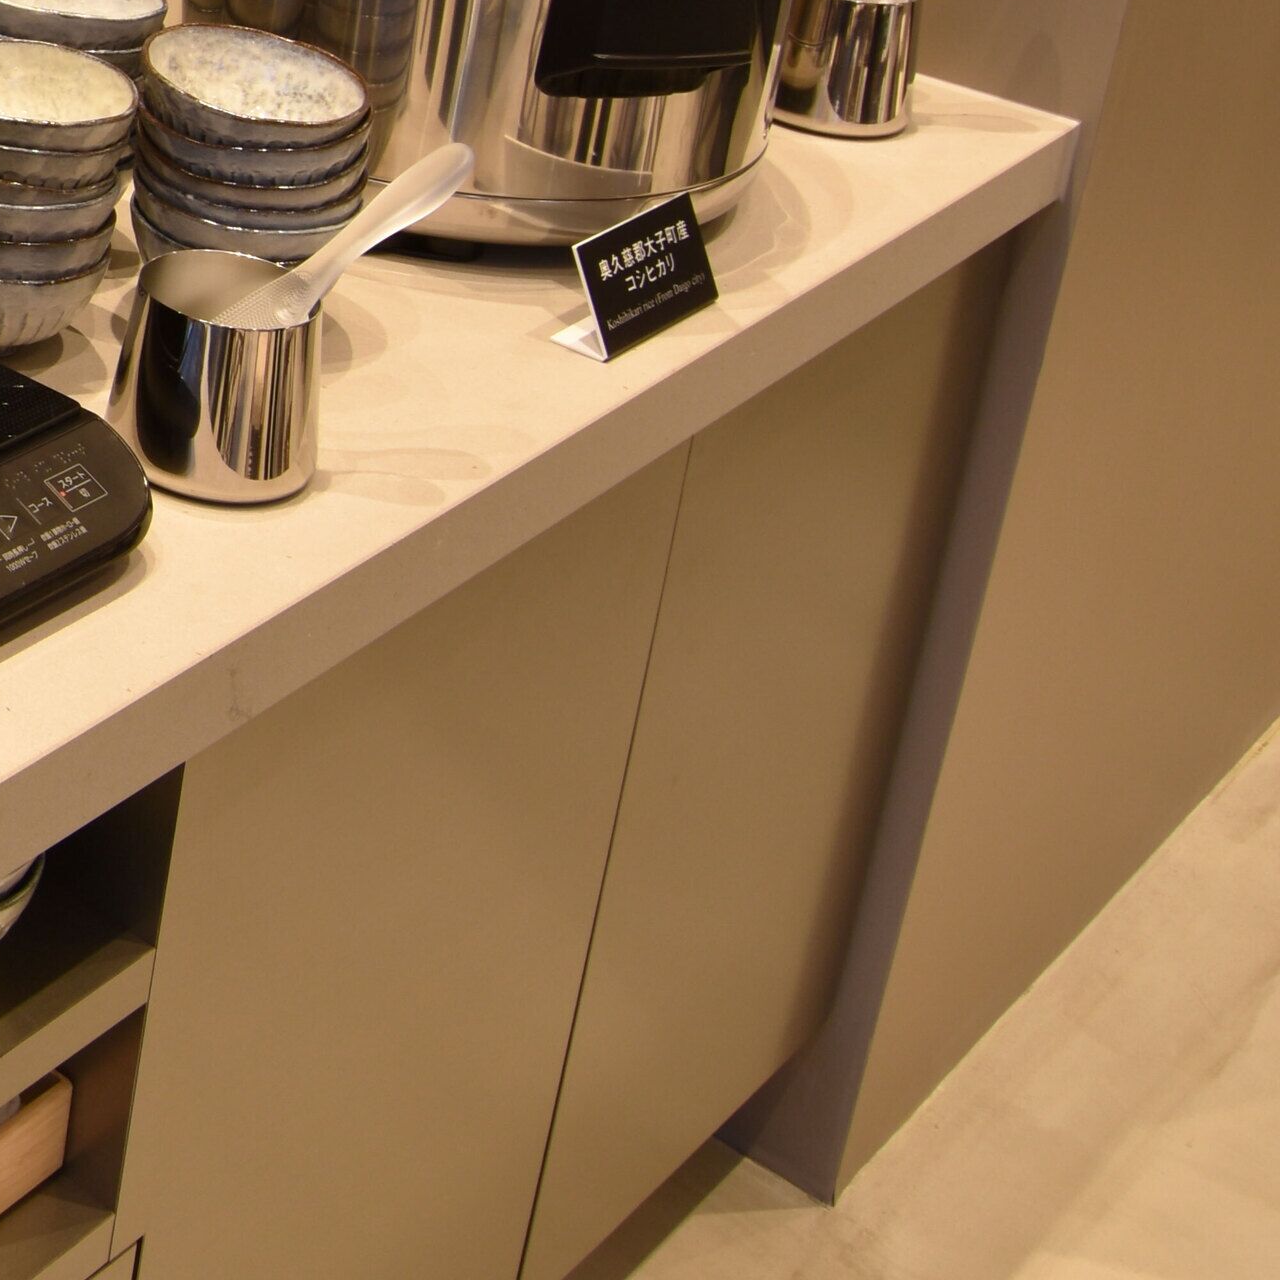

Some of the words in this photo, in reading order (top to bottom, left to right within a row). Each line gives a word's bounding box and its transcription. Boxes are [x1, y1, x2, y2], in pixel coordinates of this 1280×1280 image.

[598, 220, 690, 282] 奥久慈郡大子町産
[624, 252, 676, 293] コシヒカリ
[57, 471, 86, 489] スタート
[28, 496, 53, 514] コース
